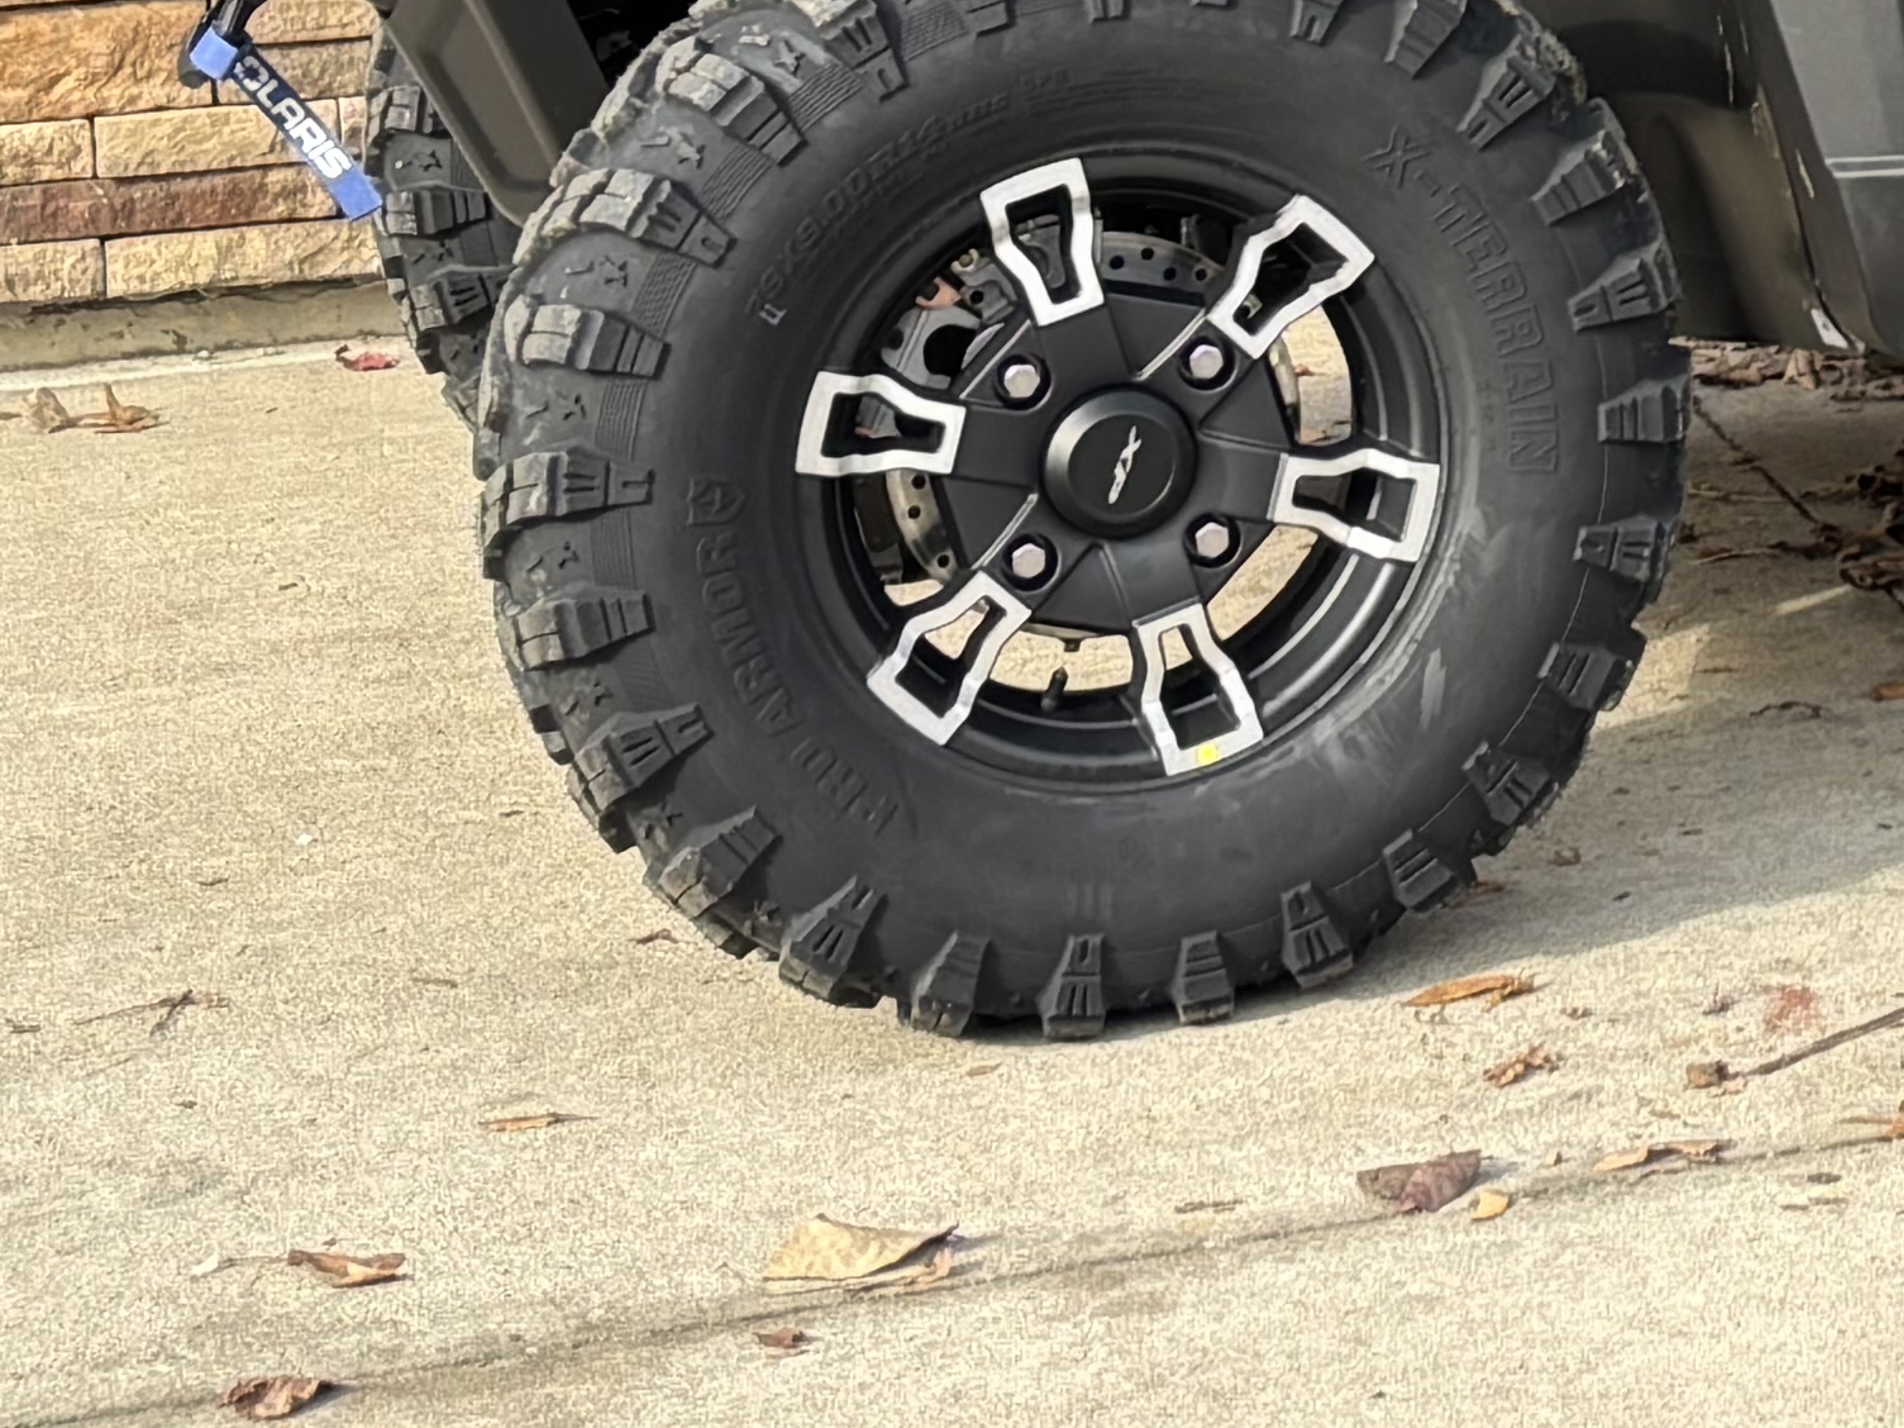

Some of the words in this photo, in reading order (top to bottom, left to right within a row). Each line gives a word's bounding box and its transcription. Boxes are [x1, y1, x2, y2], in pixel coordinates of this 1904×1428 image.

[233, 55, 353, 180] OLARIS
[1362, 124, 1559, 474] X-TERRAIN
[694, 529, 804, 738] ARMOR
